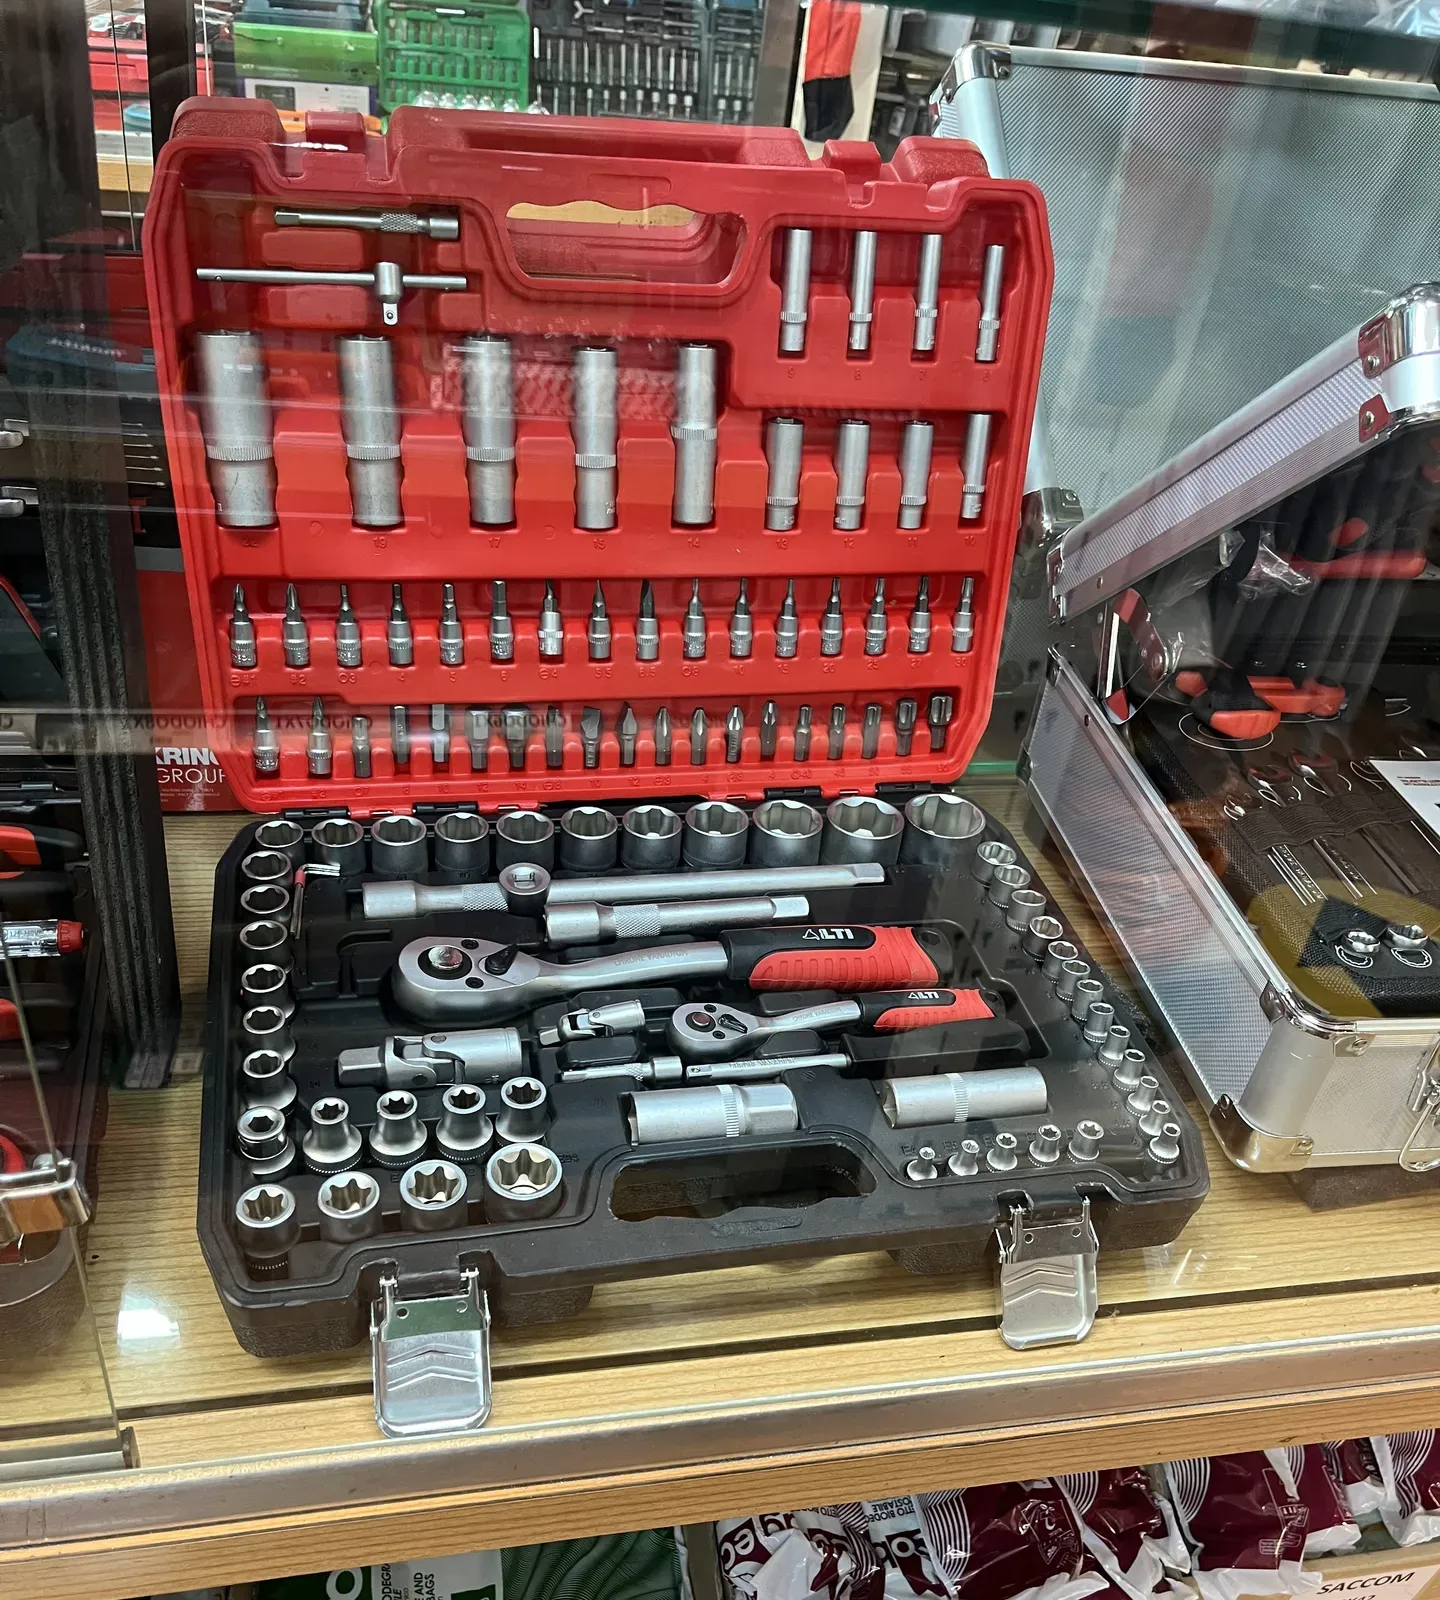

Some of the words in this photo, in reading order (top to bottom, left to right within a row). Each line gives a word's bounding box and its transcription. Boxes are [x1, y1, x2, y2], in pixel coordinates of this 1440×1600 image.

[373, 537, 388, 548] 19
[488, 537, 501, 548] 17
[593, 538, 606, 550] 15
[687, 537, 700, 548] 14
[775, 538, 788, 550] 13
[843, 538, 855, 549] 12
[907, 537, 918, 548] 11
[964, 536, 976, 547] 10
[872, 1497, 912, 1512] OSTABILE
[414, 1572, 423, 1595] AND
[1316, 1571, 1415, 1595] SACCOM
